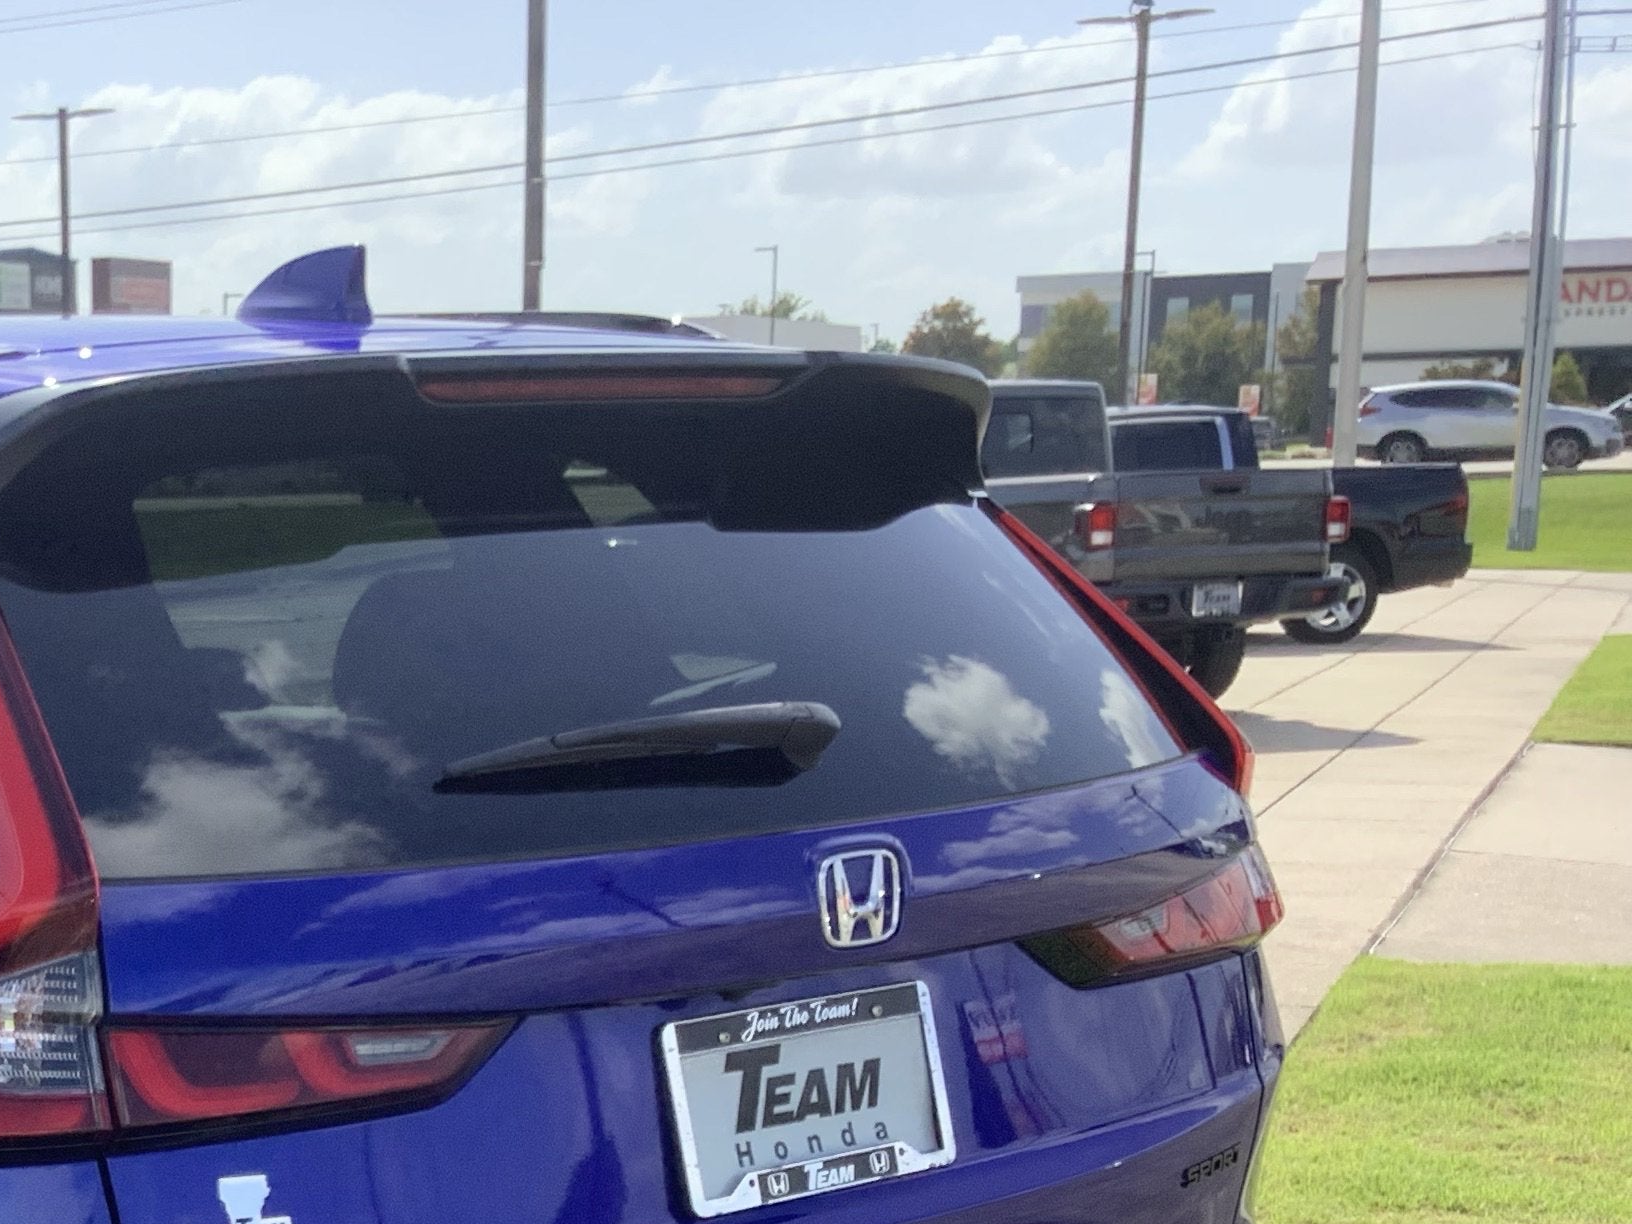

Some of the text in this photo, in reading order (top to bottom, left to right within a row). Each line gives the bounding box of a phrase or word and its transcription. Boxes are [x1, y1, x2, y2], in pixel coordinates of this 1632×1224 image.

[741, 997, 858, 1042] Join The Team!
[724, 1044, 881, 1134] TEAM
[735, 1121, 889, 1168] Honda
[1180, 1141, 1241, 1188] SPORT
[805, 1162, 855, 1191] TEAM
